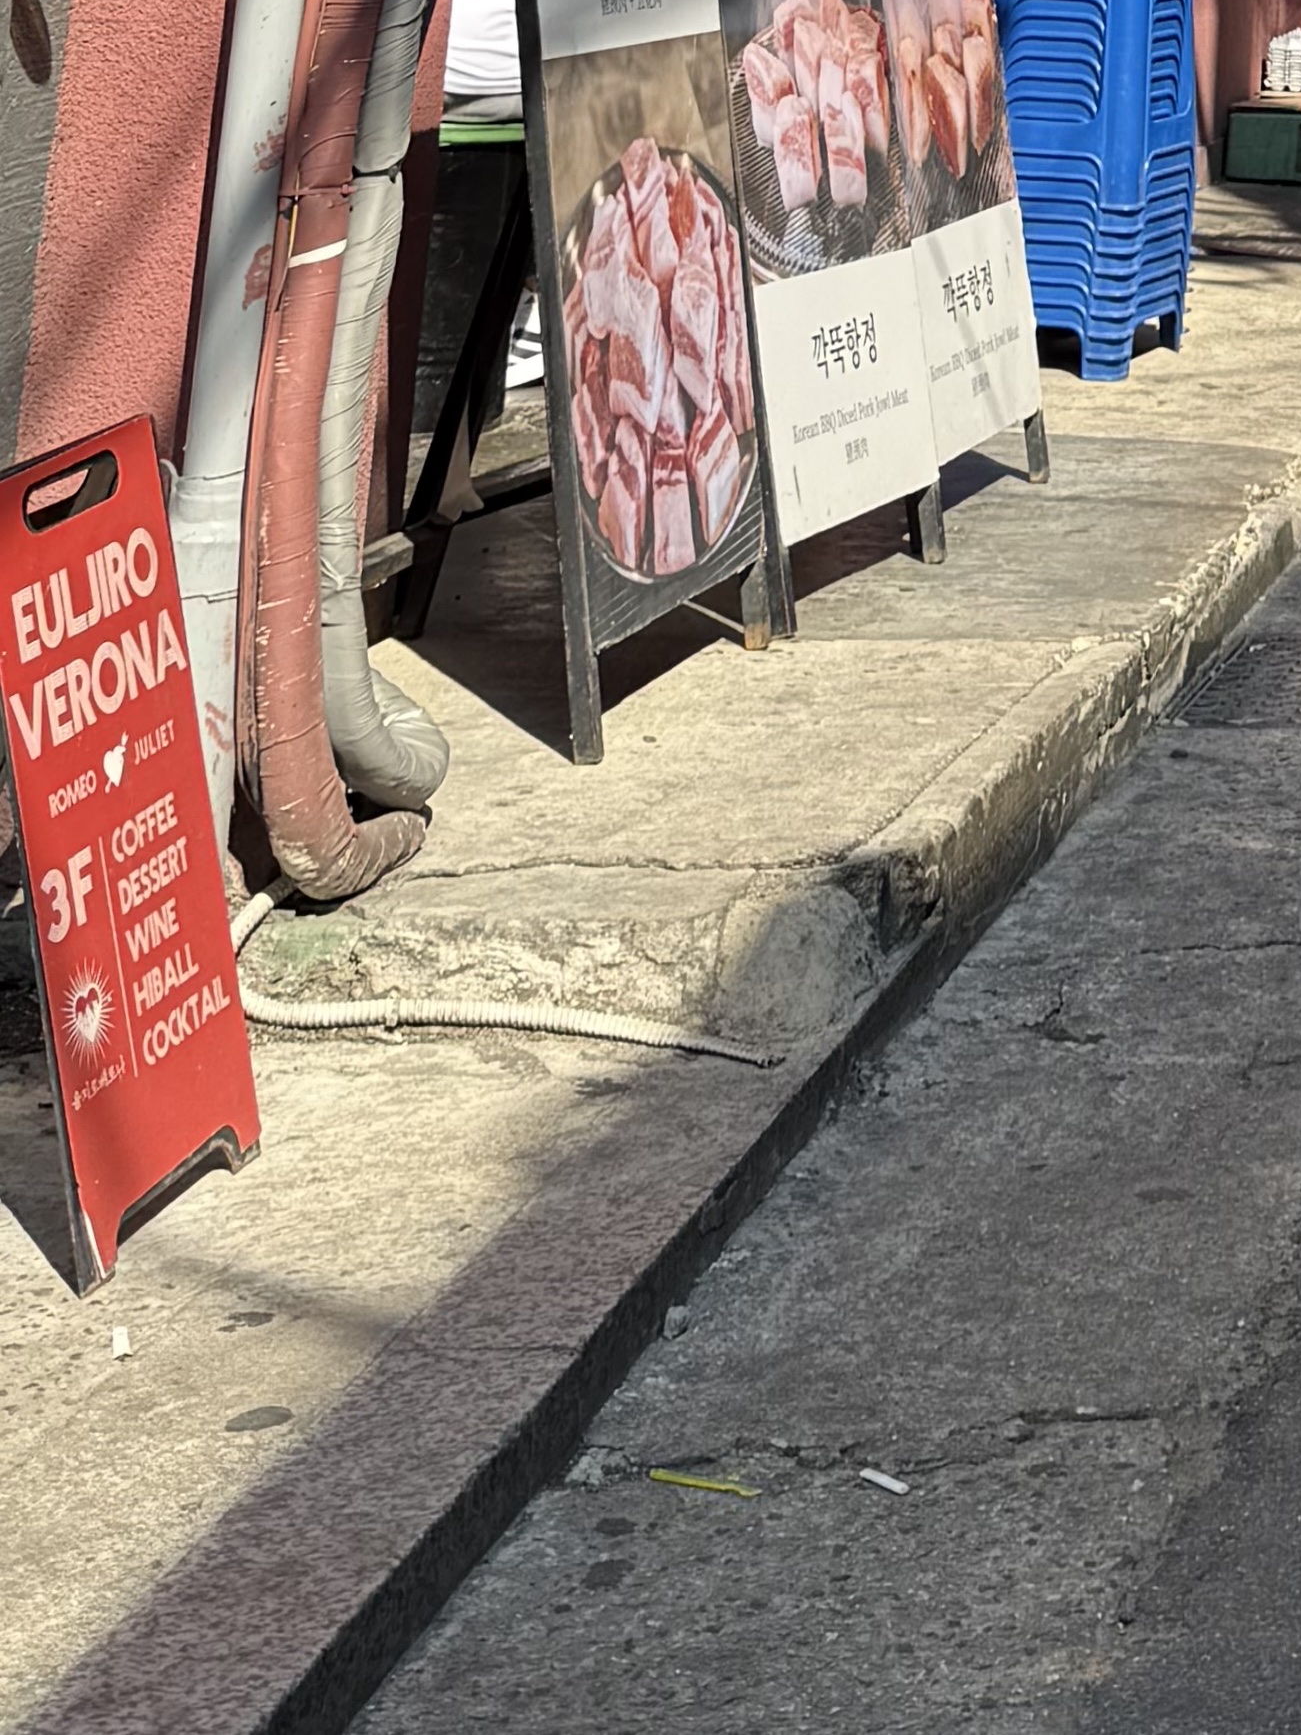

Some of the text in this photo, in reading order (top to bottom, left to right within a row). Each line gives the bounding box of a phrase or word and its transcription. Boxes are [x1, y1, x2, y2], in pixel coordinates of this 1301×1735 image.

[811, 312, 878, 379] 깍뚝항정
[792, 421, 819, 444] Korean
[11, 527, 158, 665] EULJIRO
[9, 608, 188, 761] VERONA
[48, 718, 175, 819] ROMEO JULIET
[111, 791, 178, 863] COFFEE
[40, 845, 93, 943] 3F
[117, 836, 188, 915] DESSERT
[125, 897, 180, 962] WINE
[132, 943, 199, 1017] HIBALL
[142, 976, 231, 1065] COCKTAIL
